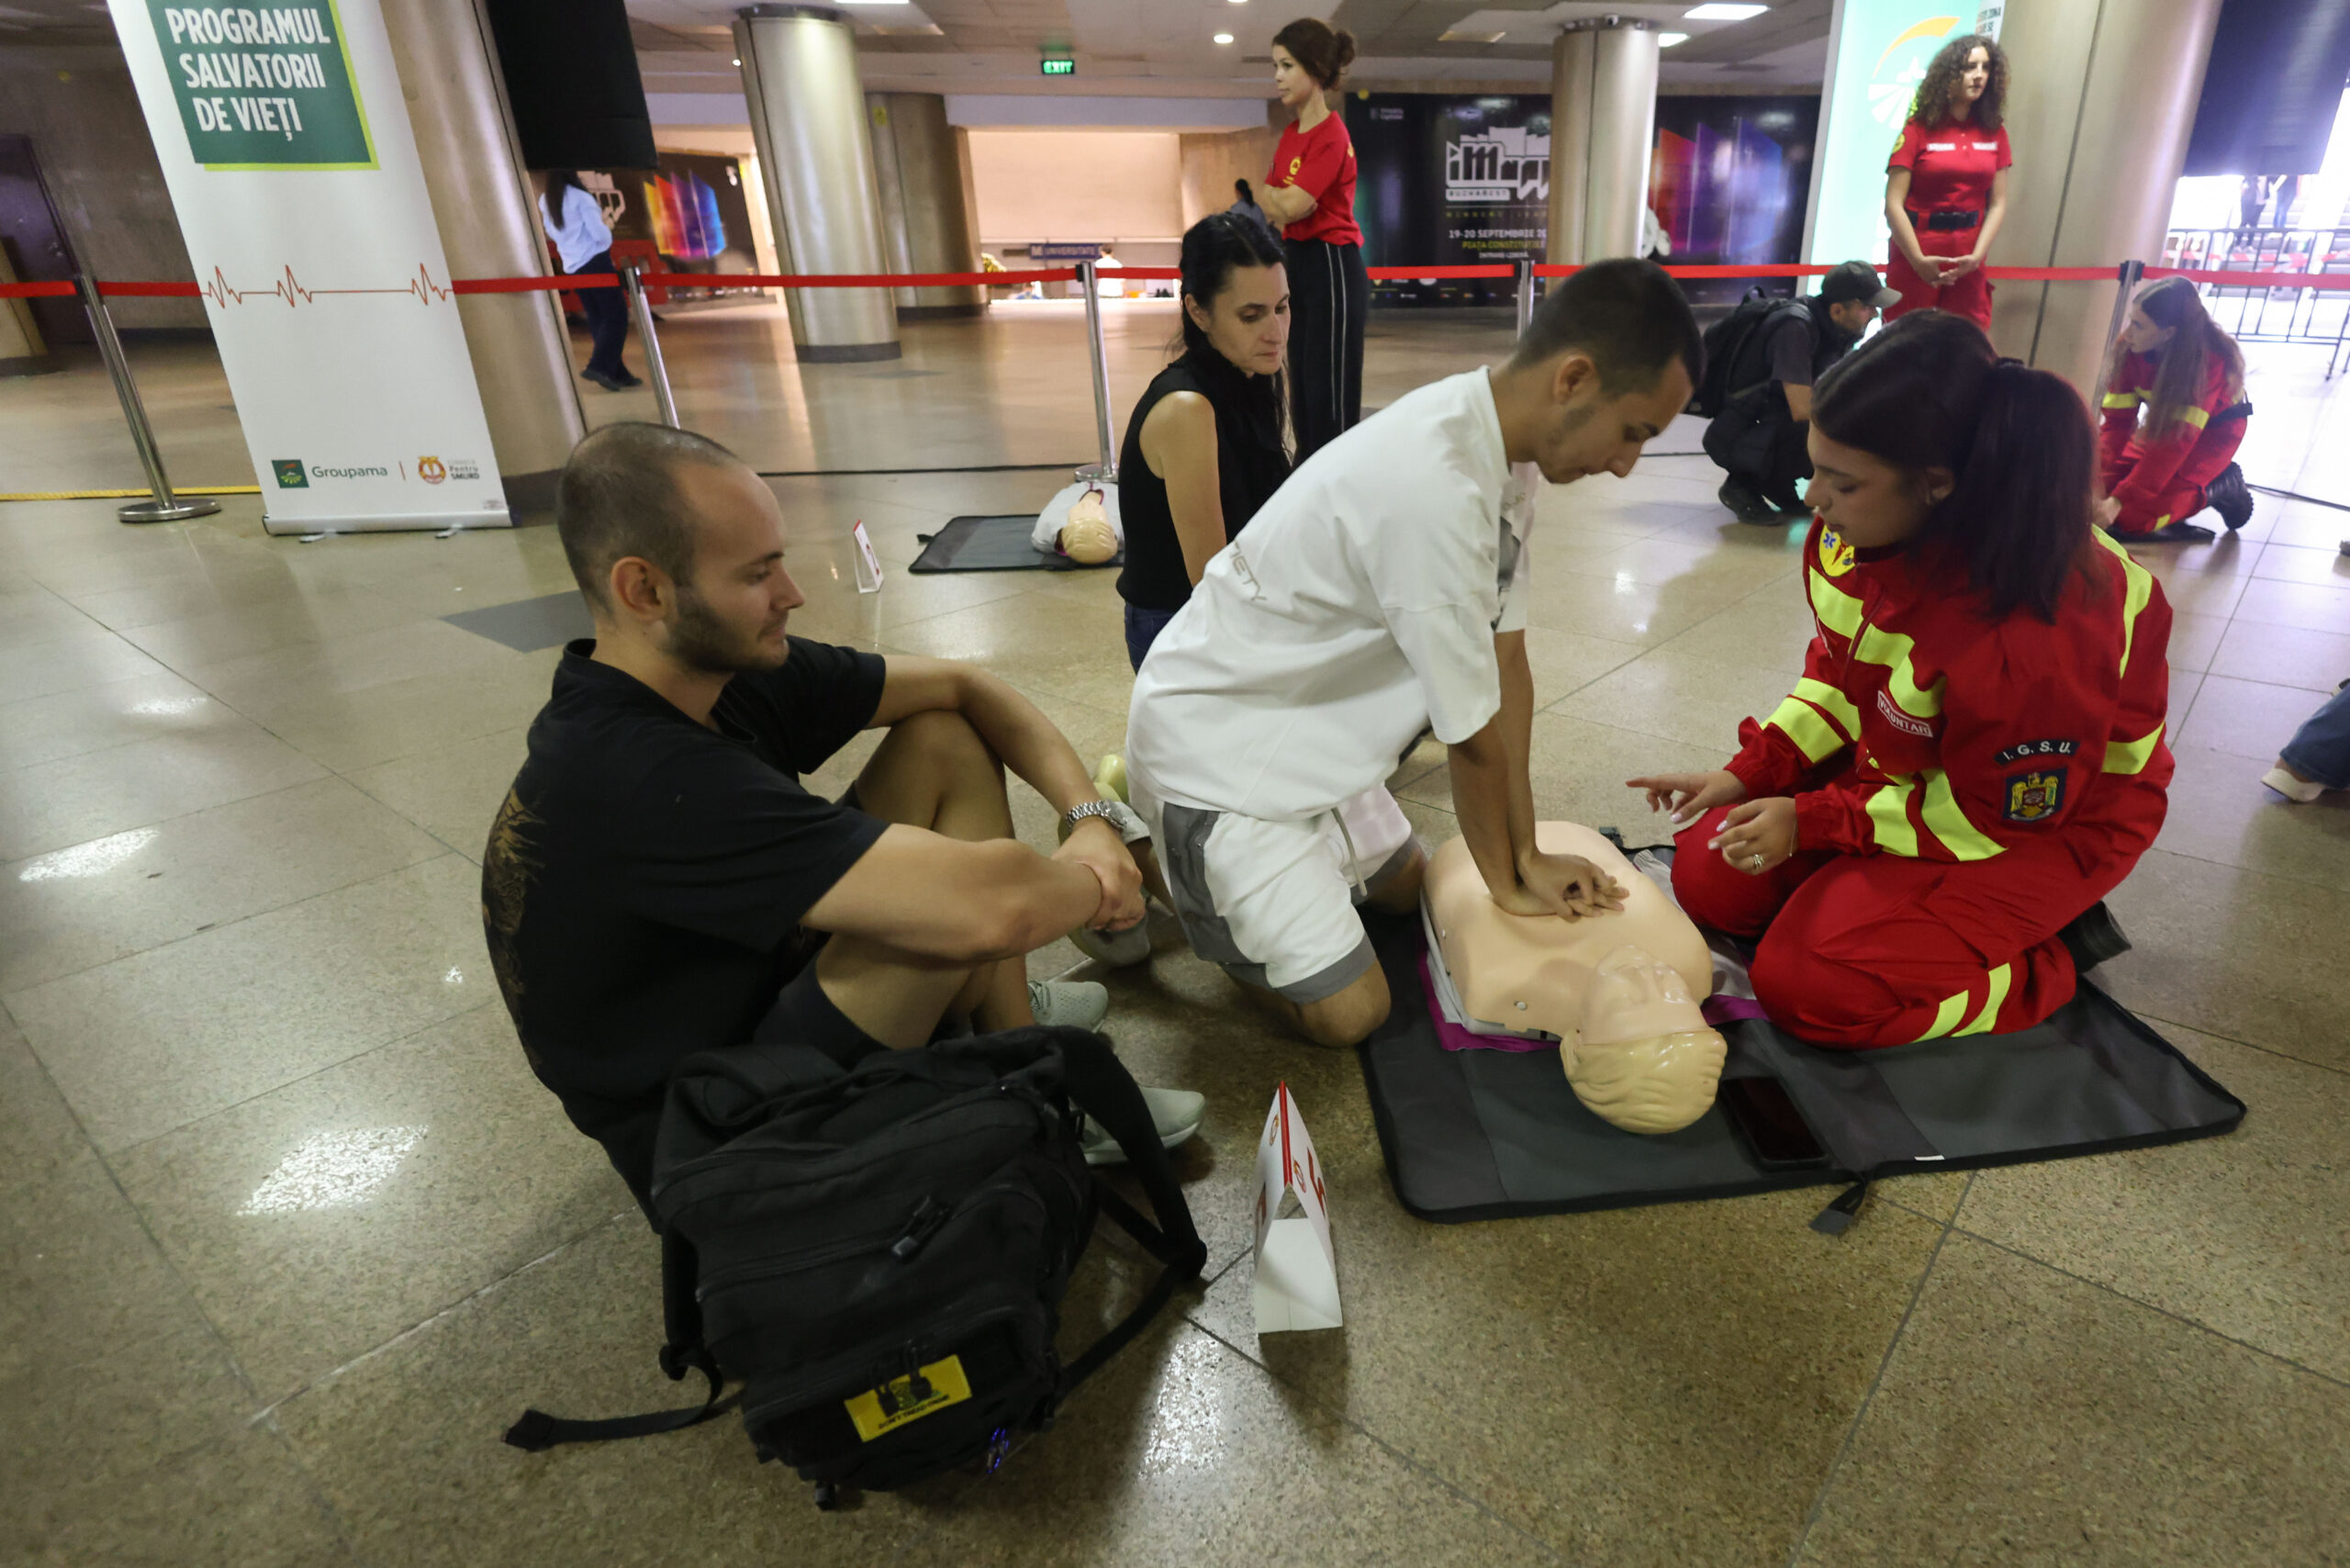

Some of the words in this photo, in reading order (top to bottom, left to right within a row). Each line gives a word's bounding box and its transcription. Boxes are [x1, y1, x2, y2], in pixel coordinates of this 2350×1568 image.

[164, 8, 331, 45] PROGRAMUL
[178, 53, 327, 89] SALVATORII
[1043, 61, 1073, 73] EXIT
[193, 98, 232, 131] DE
[229, 97, 303, 140] VIEȚI
[1449, 229, 1476, 239] 19-20
[1477, 229, 1535, 239] SEPTEMBRIE
[311, 465, 388, 479] Groupama
[449, 465, 479, 473] Pentru
[451, 472, 480, 481] SMURD
